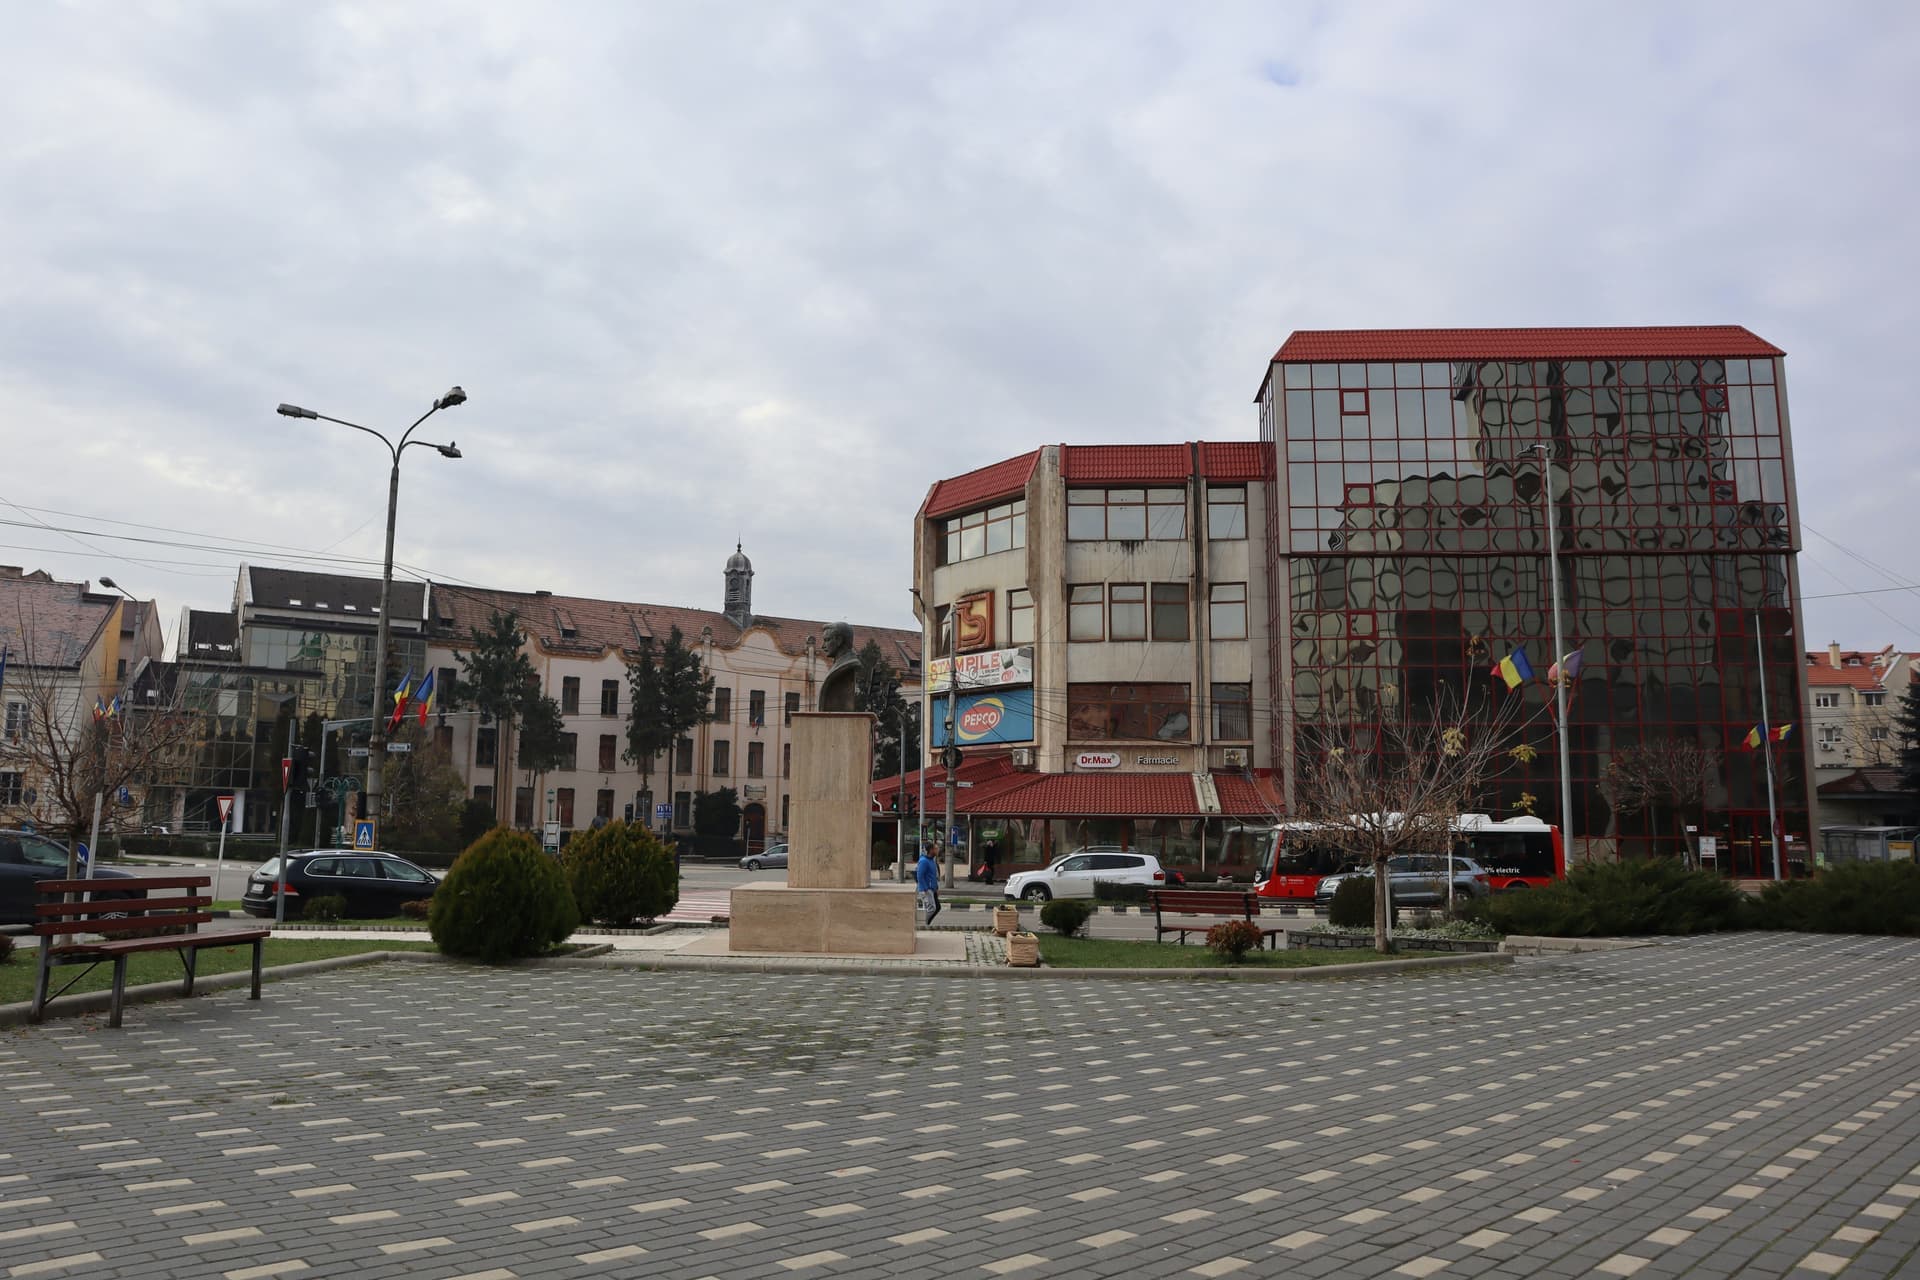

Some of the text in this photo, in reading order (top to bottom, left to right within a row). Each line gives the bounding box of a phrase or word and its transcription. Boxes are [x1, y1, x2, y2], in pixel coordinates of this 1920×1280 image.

[930, 653, 1000, 672] STAMPILE
[964, 712, 997, 727] PEPCO
[1081, 756, 1179, 765] Dr.Max Farmacie
